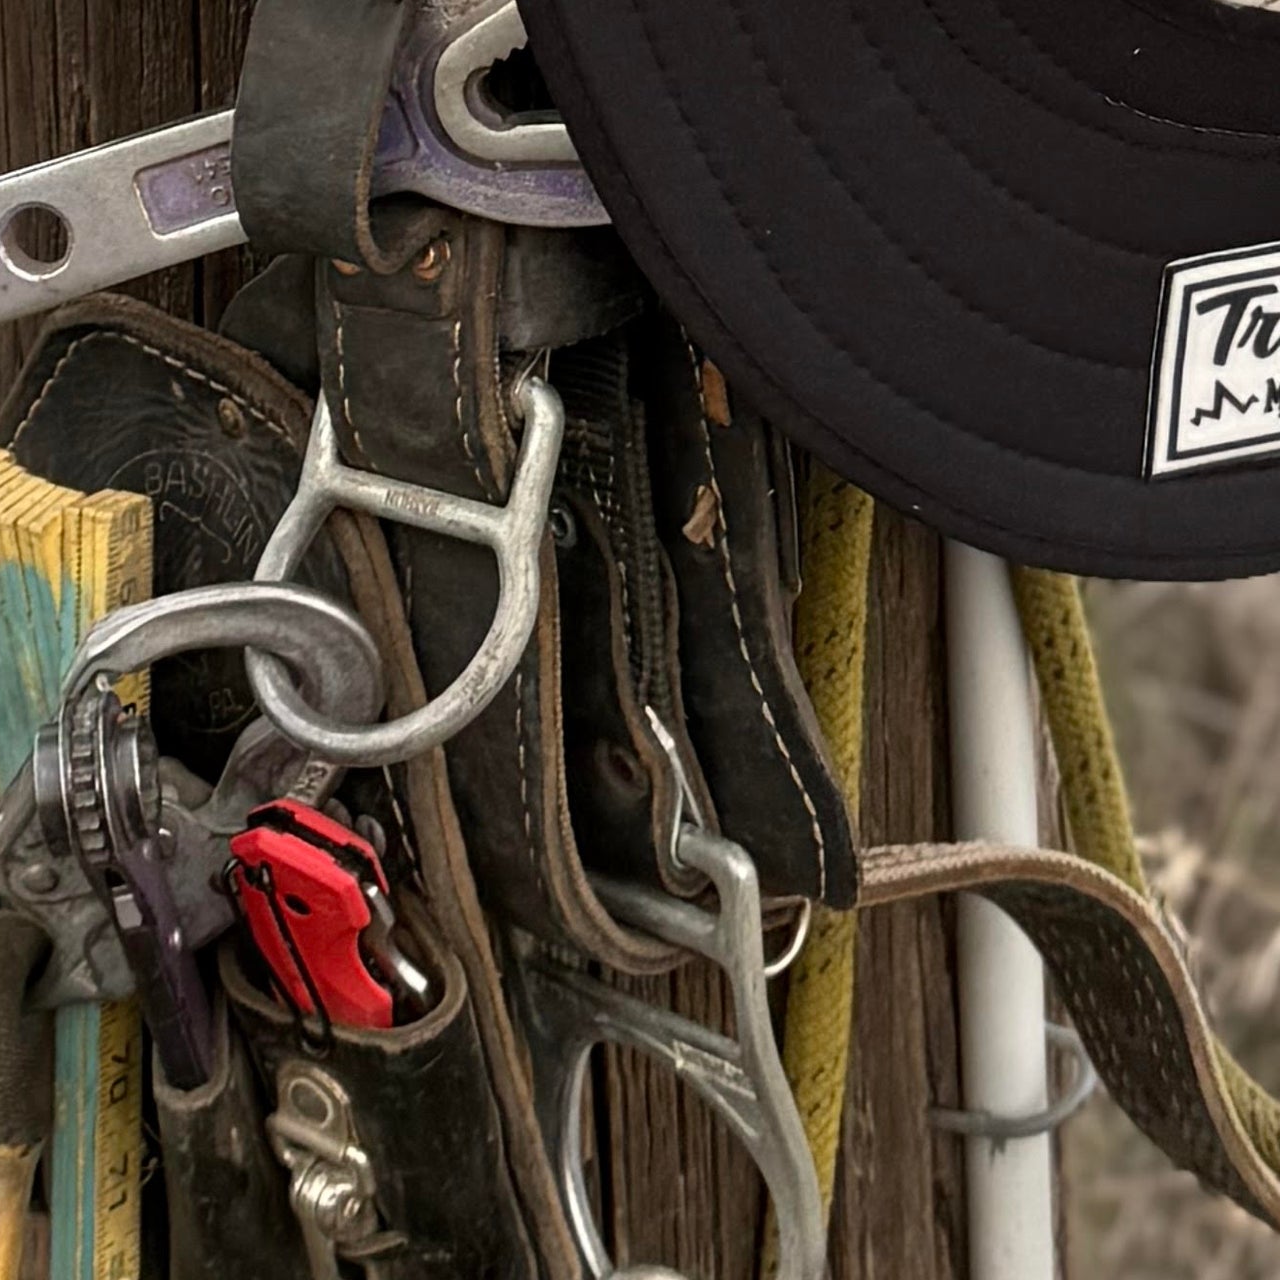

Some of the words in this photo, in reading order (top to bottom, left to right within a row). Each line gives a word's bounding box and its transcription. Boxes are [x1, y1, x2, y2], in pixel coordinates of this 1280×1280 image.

[143, 459, 260, 565] BASHLIN
[109, 1041, 131, 1105] 70
[108, 1151, 129, 1212] 71
